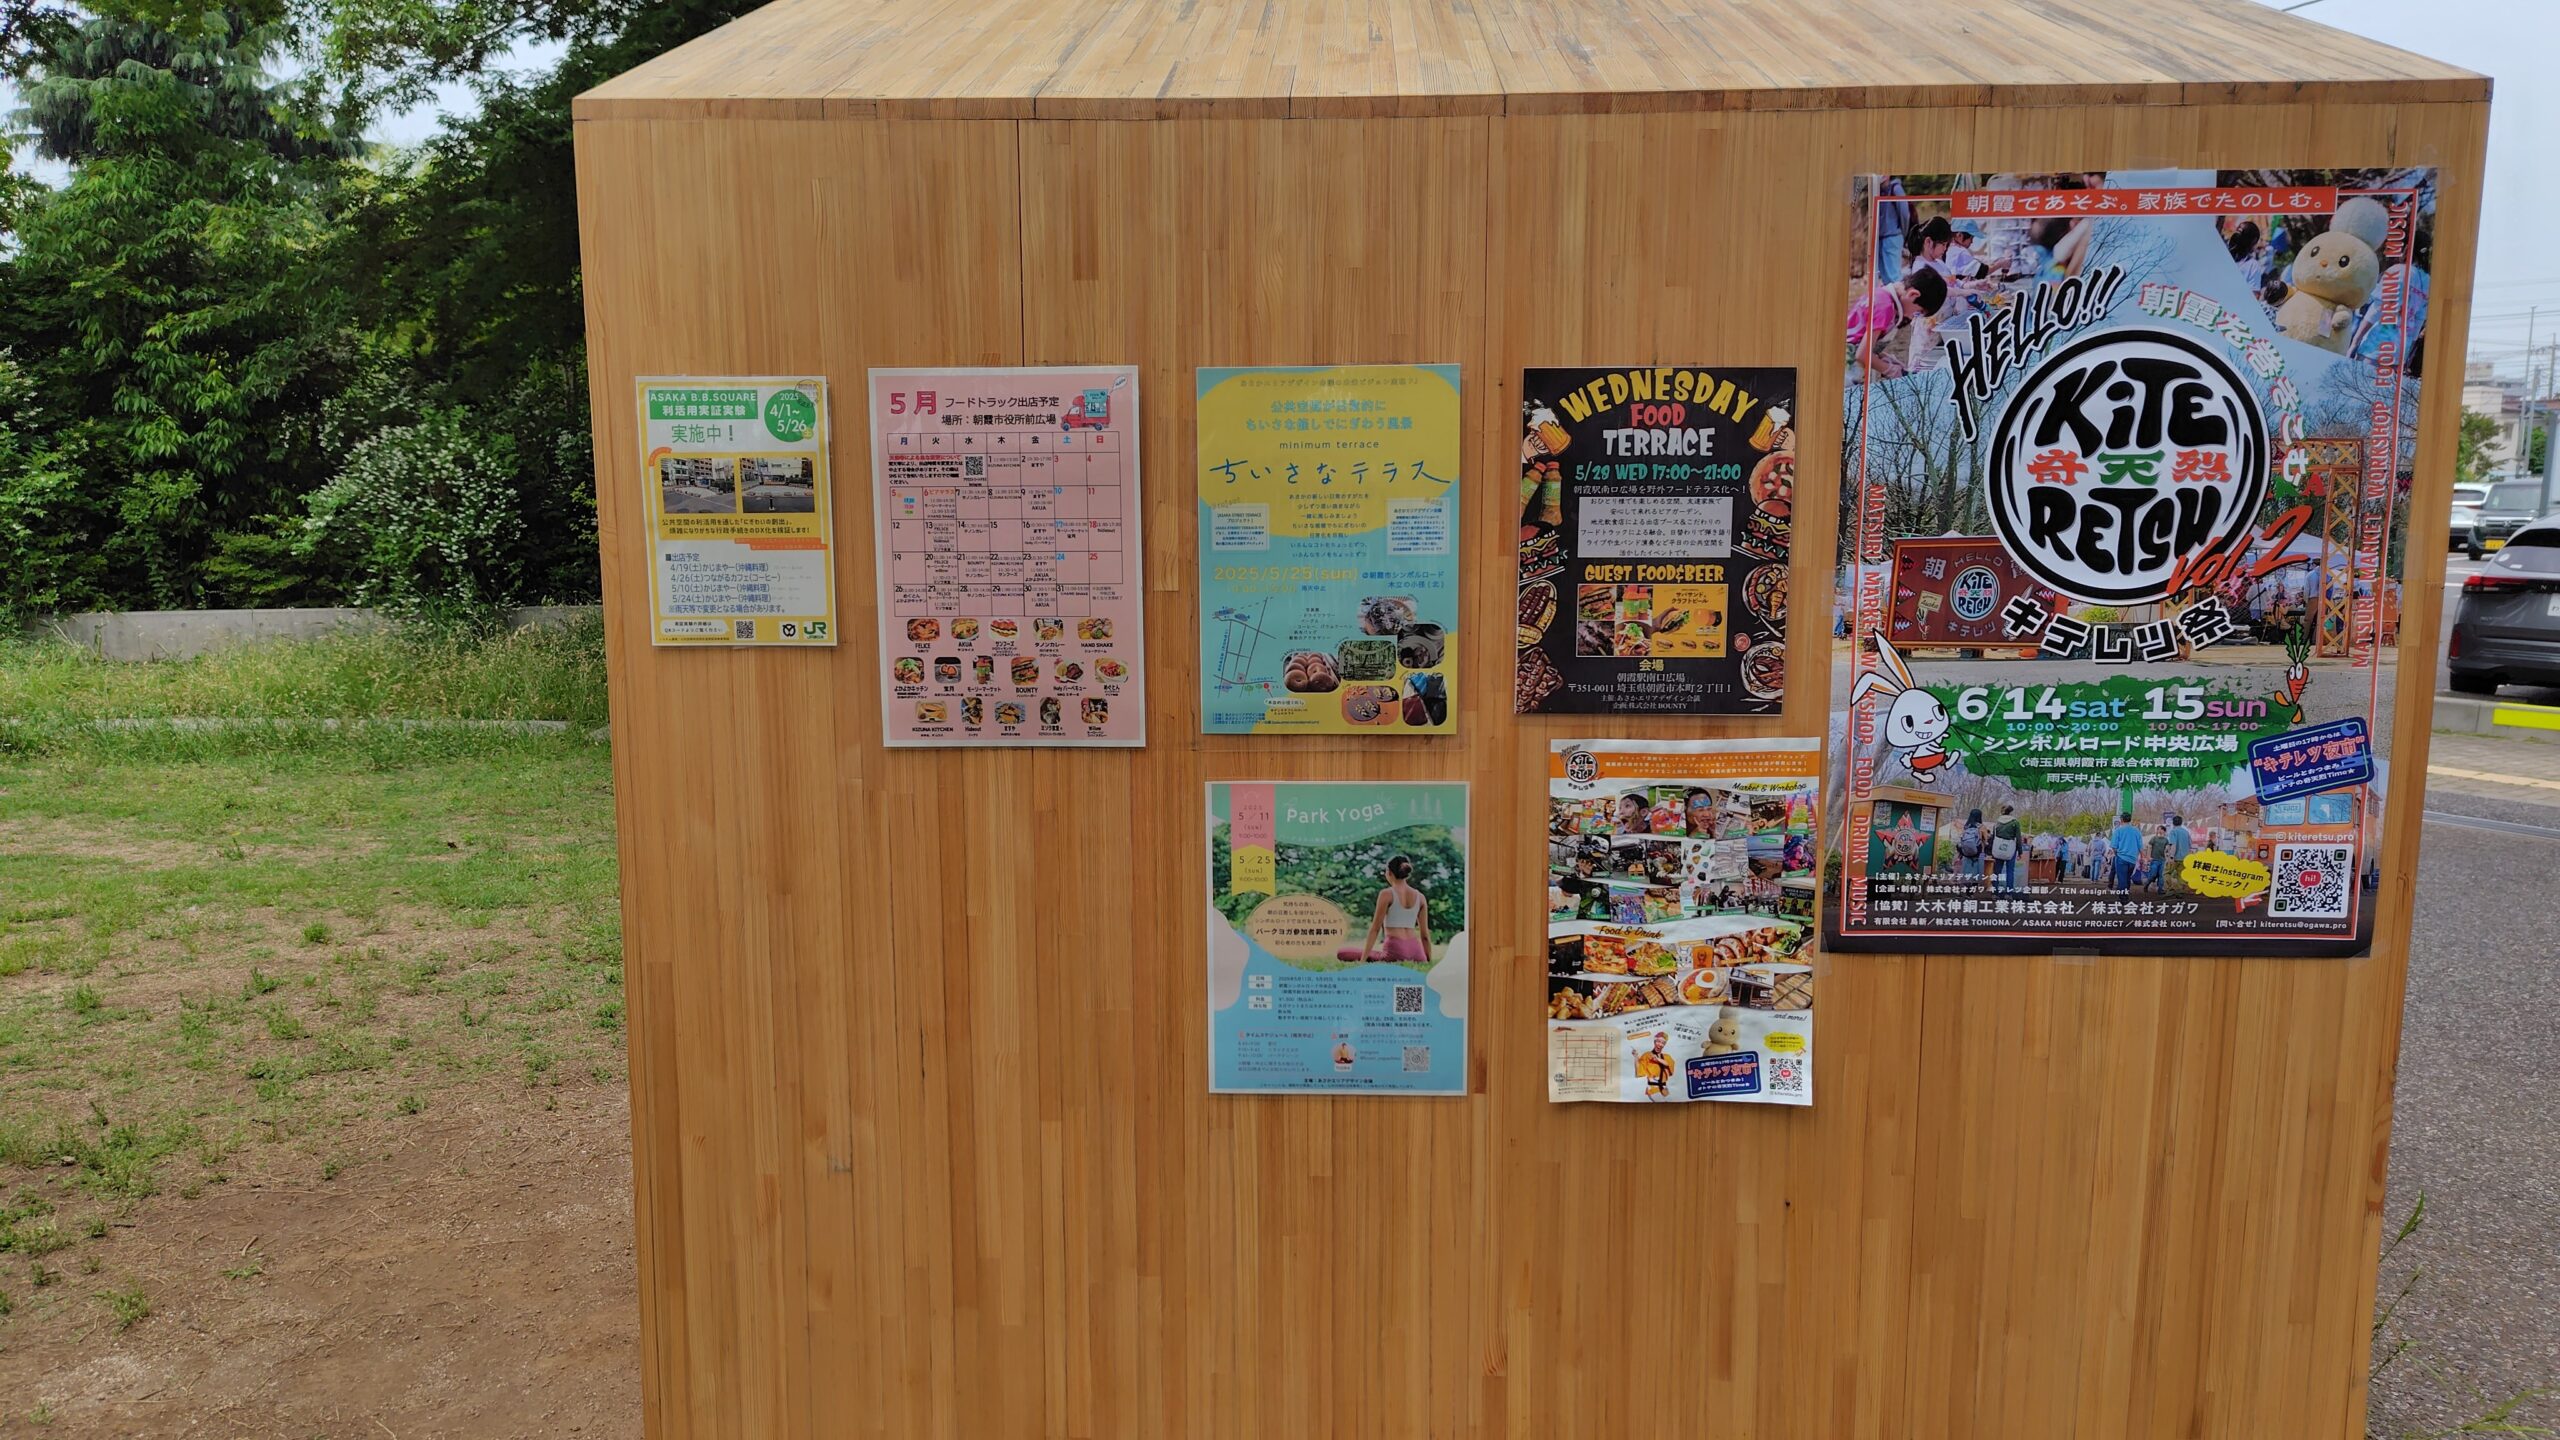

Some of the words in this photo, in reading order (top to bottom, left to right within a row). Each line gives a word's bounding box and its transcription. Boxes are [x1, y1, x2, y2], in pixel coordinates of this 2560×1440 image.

[1966, 191, 2322, 213] 朝霞であそぶ。家族でたのしむ。
[2384, 200, 2409, 257] MUSIC
[2381, 270, 2400, 325] DRINK
[1945, 265, 2125, 442] HELLO!!
[2376, 341, 2395, 387] FOOD
[650, 393, 687, 402] ASAKA
[691, 392, 757, 402] B.B.SQUARE
[945, 396, 1060, 409] フードトラック出店予定
[1559, 369, 1759, 424] WEDNESDAY
[662, 405, 746, 417] 利活用実証実験
[942, 414, 1057, 426] 場所：朝霞市役所前広場
[1630, 403, 1686, 427] FOOD
[776, 419, 807, 433] 5/26
[901, 437, 908, 445] 月
[932, 437, 940, 445] 火
[965, 437, 973, 445] 水
[997, 437, 1006, 445] 木
[1031, 436, 1040, 444] 金
[1064, 436, 1071, 444] 土
[1096, 436, 1104, 444] 日
[1279, 441, 1331, 449] minimum
[1336, 440, 1380, 449] terrace
[1602, 427, 1715, 457] TERRACE
[2367, 401, 2391, 500] WORKSHOP
[1209, 458, 1451, 485] ちいさなテラス
[1615, 464, 1648, 480] WED
[2026, 449, 2232, 487] 奇天烈
[1863, 483, 1887, 558] MATSURI
[2359, 511, 2382, 583] MARKET
[1922, 557, 1946, 580] 朝
[1954, 552, 2003, 568] HELLO
[1585, 564, 1633, 582] GUEST
[804, 622, 827, 635] JR
[1948, 621, 1996, 636] キテレツ
[2000, 596, 2234, 664] キテレツ祭
[2351, 594, 2375, 669] MATSURI
[1639, 659, 1664, 672] 会場
[1617, 673, 1686, 683] 朝霞駅南口広場
[1658, 702, 1688, 710] BOUNTY
[1857, 651, 1878, 745] WKSHOP
[1983, 734, 2240, 753] シンボルロード中央広場
[1855, 757, 1874, 798] FOOD
[2046, 772, 2172, 784] 雨天中止・小雨決行
[1731, 782, 1759, 792] Market
[1287, 807, 1330, 824] Park
[1336, 802, 1384, 823] Yoga
[1851, 815, 1871, 864] DRINK
[2288, 832, 2355, 843] kiteretsu.pro
[1850, 877, 1868, 925] MUSIC
[2080, 888, 2107, 897] design
[1598, 925, 1625, 936] Food
[1634, 926, 1663, 940] Drink
[1971, 919, 2010, 927] TOHIONA
[2022, 920, 2052, 928] ASAKA
[2054, 920, 2082, 928] MUSIC
[2084, 920, 2123, 928] PROJECT
[2260, 920, 2347, 930] kiteretsu@ogawa.pro
